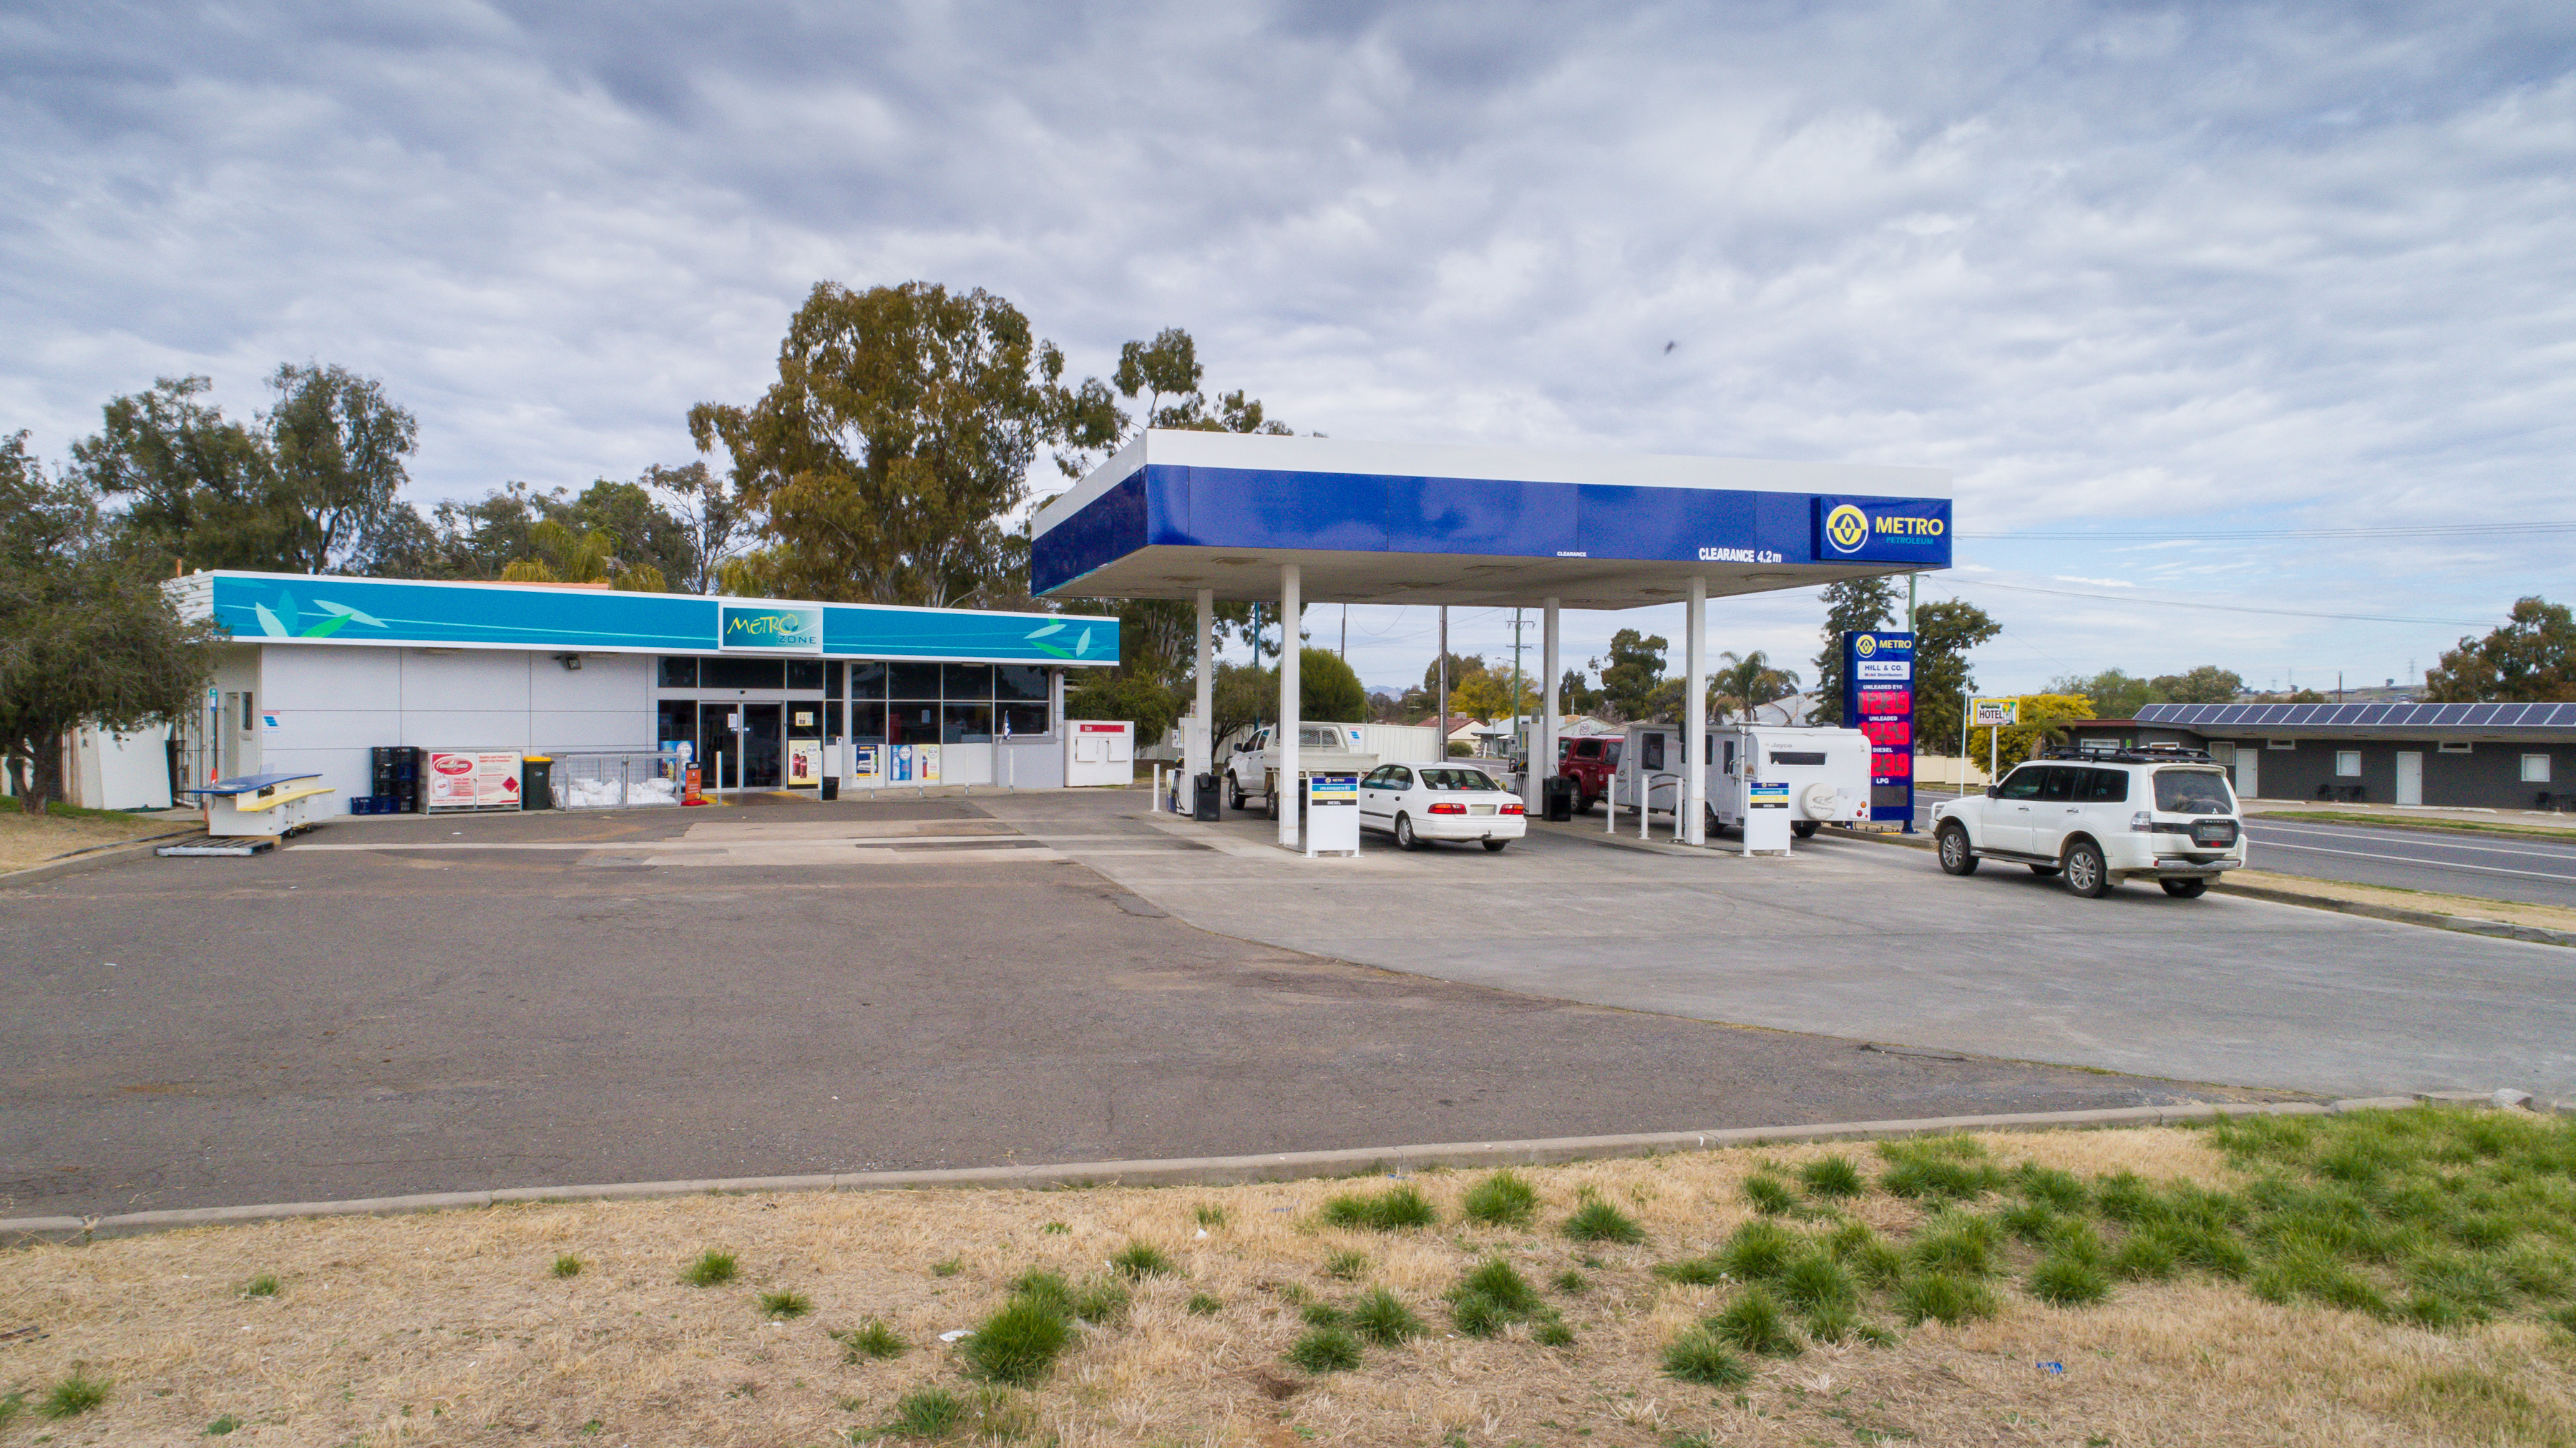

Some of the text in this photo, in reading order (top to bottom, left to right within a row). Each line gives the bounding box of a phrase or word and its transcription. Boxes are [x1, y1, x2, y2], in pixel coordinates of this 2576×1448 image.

[1875, 517, 1943, 535] METRO
[1699, 548, 1755, 562] CLEARANCE
[727, 614, 798, 634] METRO
[779, 636, 816, 644] ZONE
[1878, 640, 1912, 648] METRO
[1979, 710, 2002, 719] HOTEL
